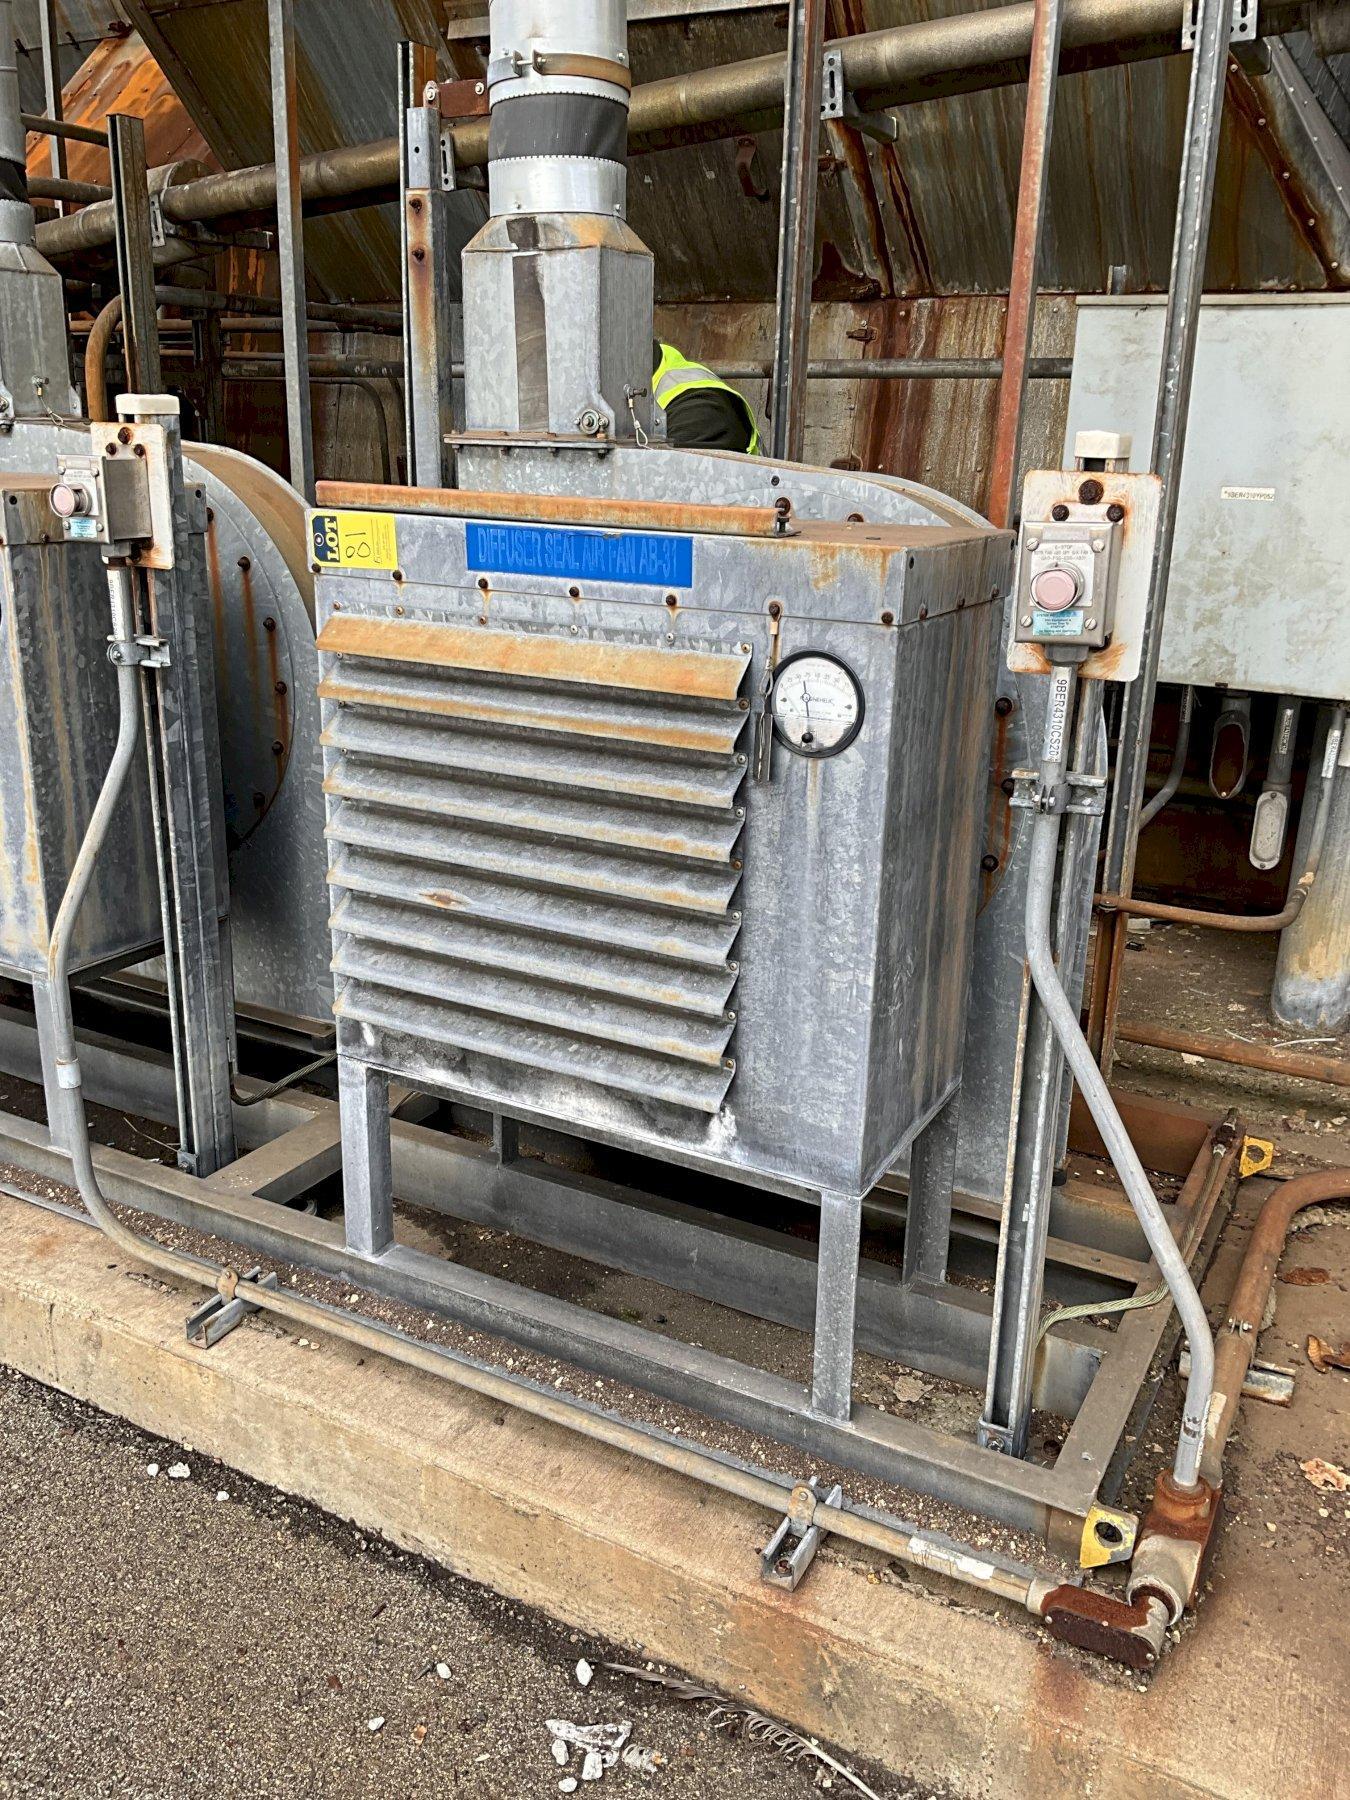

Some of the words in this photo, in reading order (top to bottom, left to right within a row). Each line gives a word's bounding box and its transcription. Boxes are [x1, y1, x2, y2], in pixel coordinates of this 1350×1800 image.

[324, 517, 339, 561] LOT
[345, 531, 372, 559] 81
[477, 527, 542, 567] DIFFUSER
[544, 531, 579, 570] SEAL
[582, 535, 604, 572] AIR
[608, 537, 637, 574] FAN
[639, 539, 678, 578] AB-31
